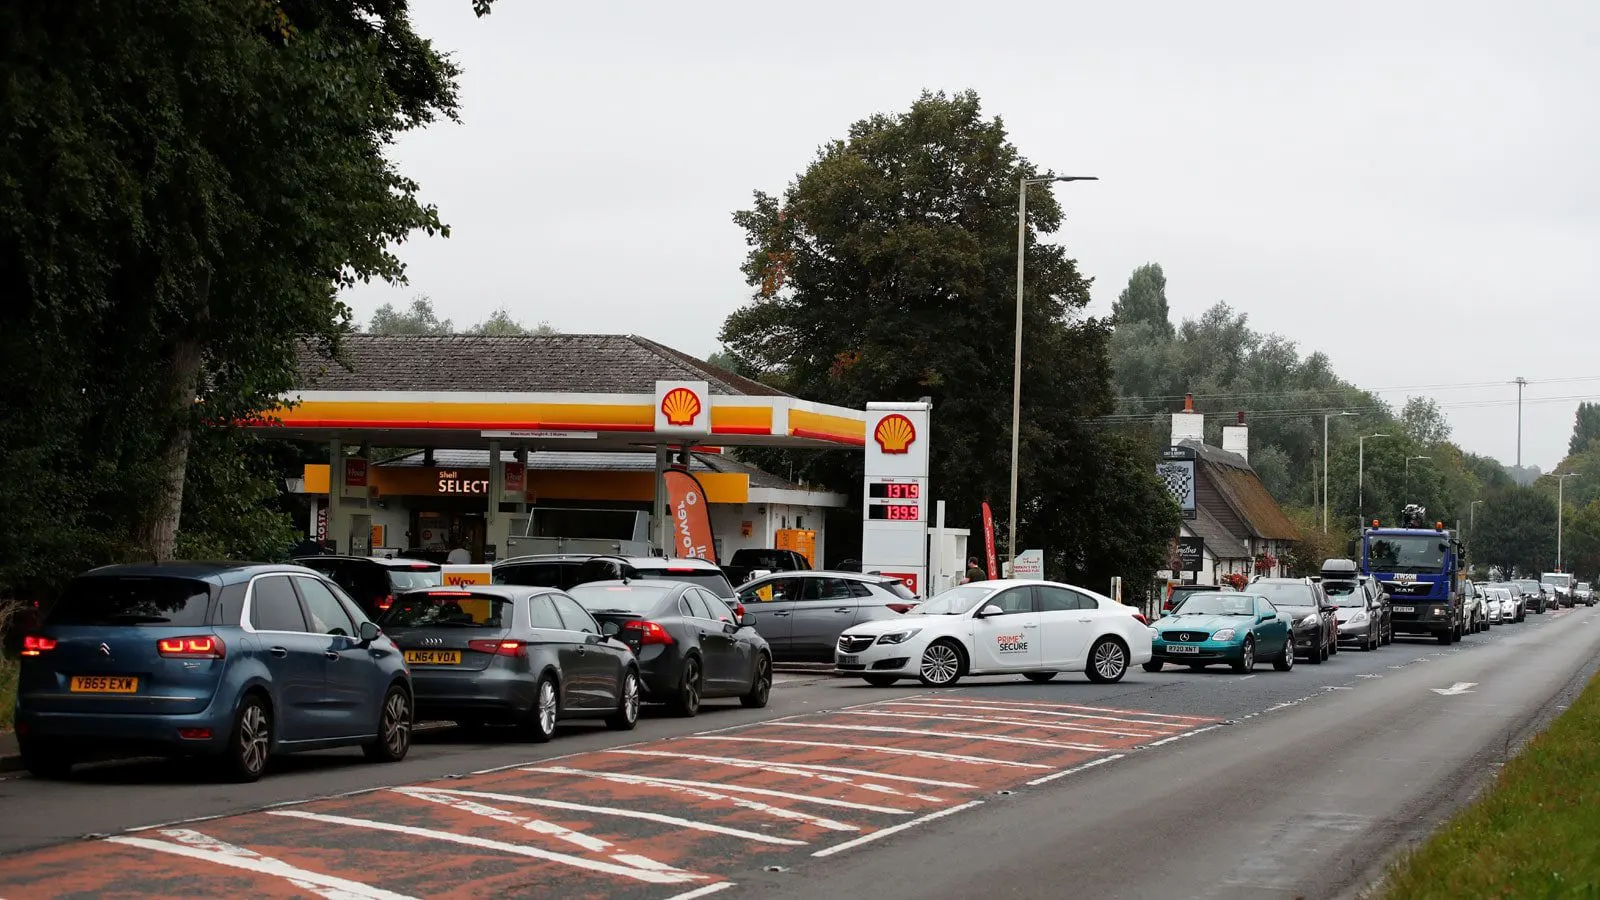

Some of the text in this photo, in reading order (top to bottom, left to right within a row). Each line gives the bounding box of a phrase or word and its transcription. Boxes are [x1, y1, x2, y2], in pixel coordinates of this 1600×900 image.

[440, 471, 458, 479] Shell
[888, 484, 918, 498] 137.9
[887, 506, 918, 520] 139.9
[318, 508, 326, 541] COSTA
[998, 636, 1018, 644] PRIME
[1000, 642, 1028, 651] SECURE
[408, 652, 434, 662] LN64
[76, 678, 132, 690] YB65 EXW
